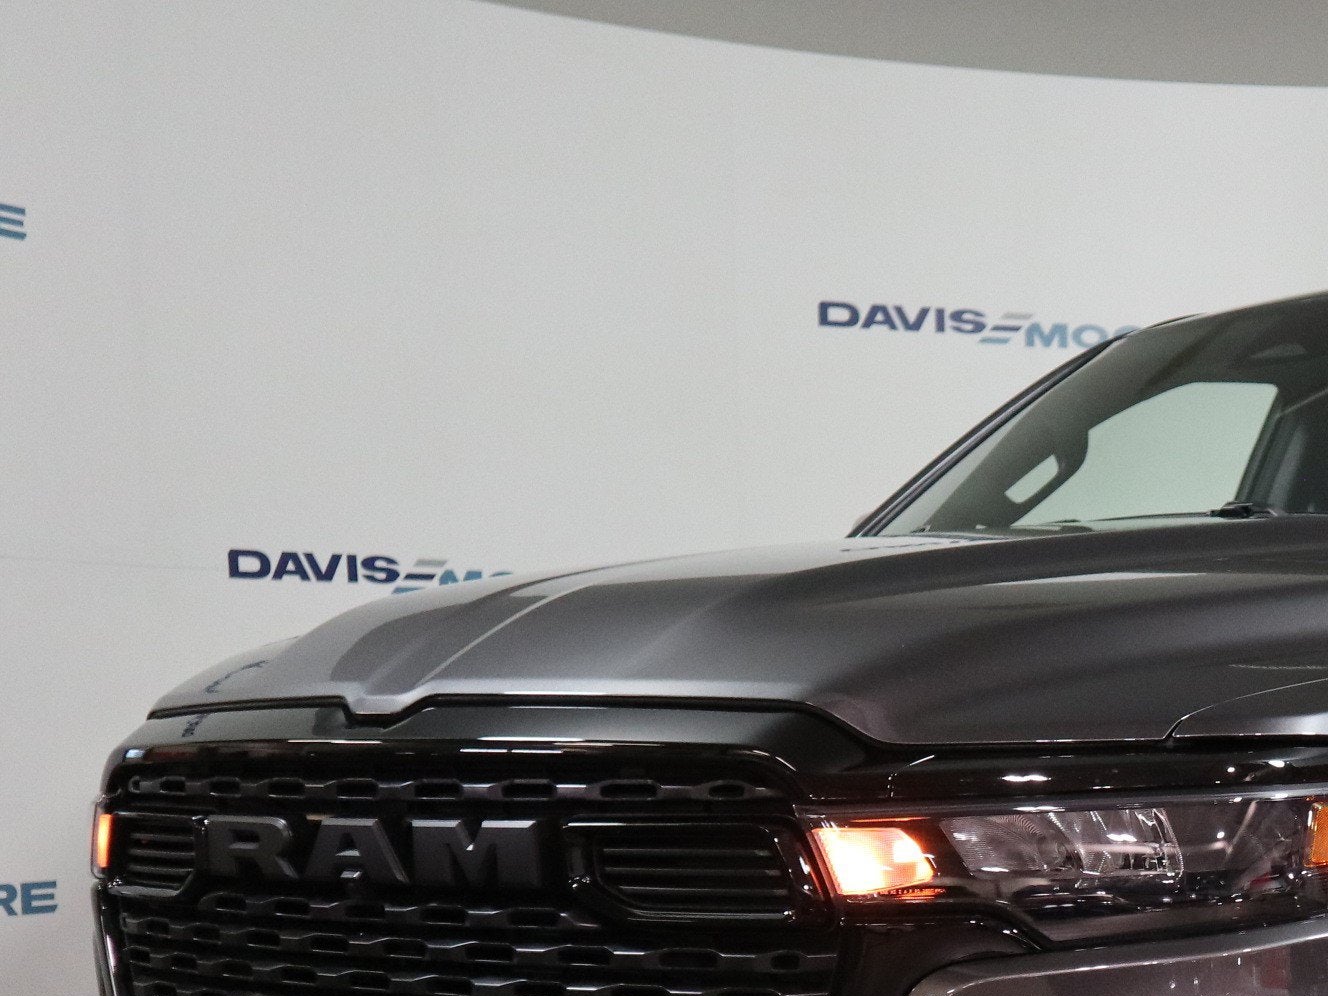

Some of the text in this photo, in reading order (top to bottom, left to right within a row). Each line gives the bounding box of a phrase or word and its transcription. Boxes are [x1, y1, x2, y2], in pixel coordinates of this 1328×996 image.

[818, 300, 987, 334] DAVIS
[227, 549, 400, 584] DAVIS
[203, 815, 548, 888] RAM
